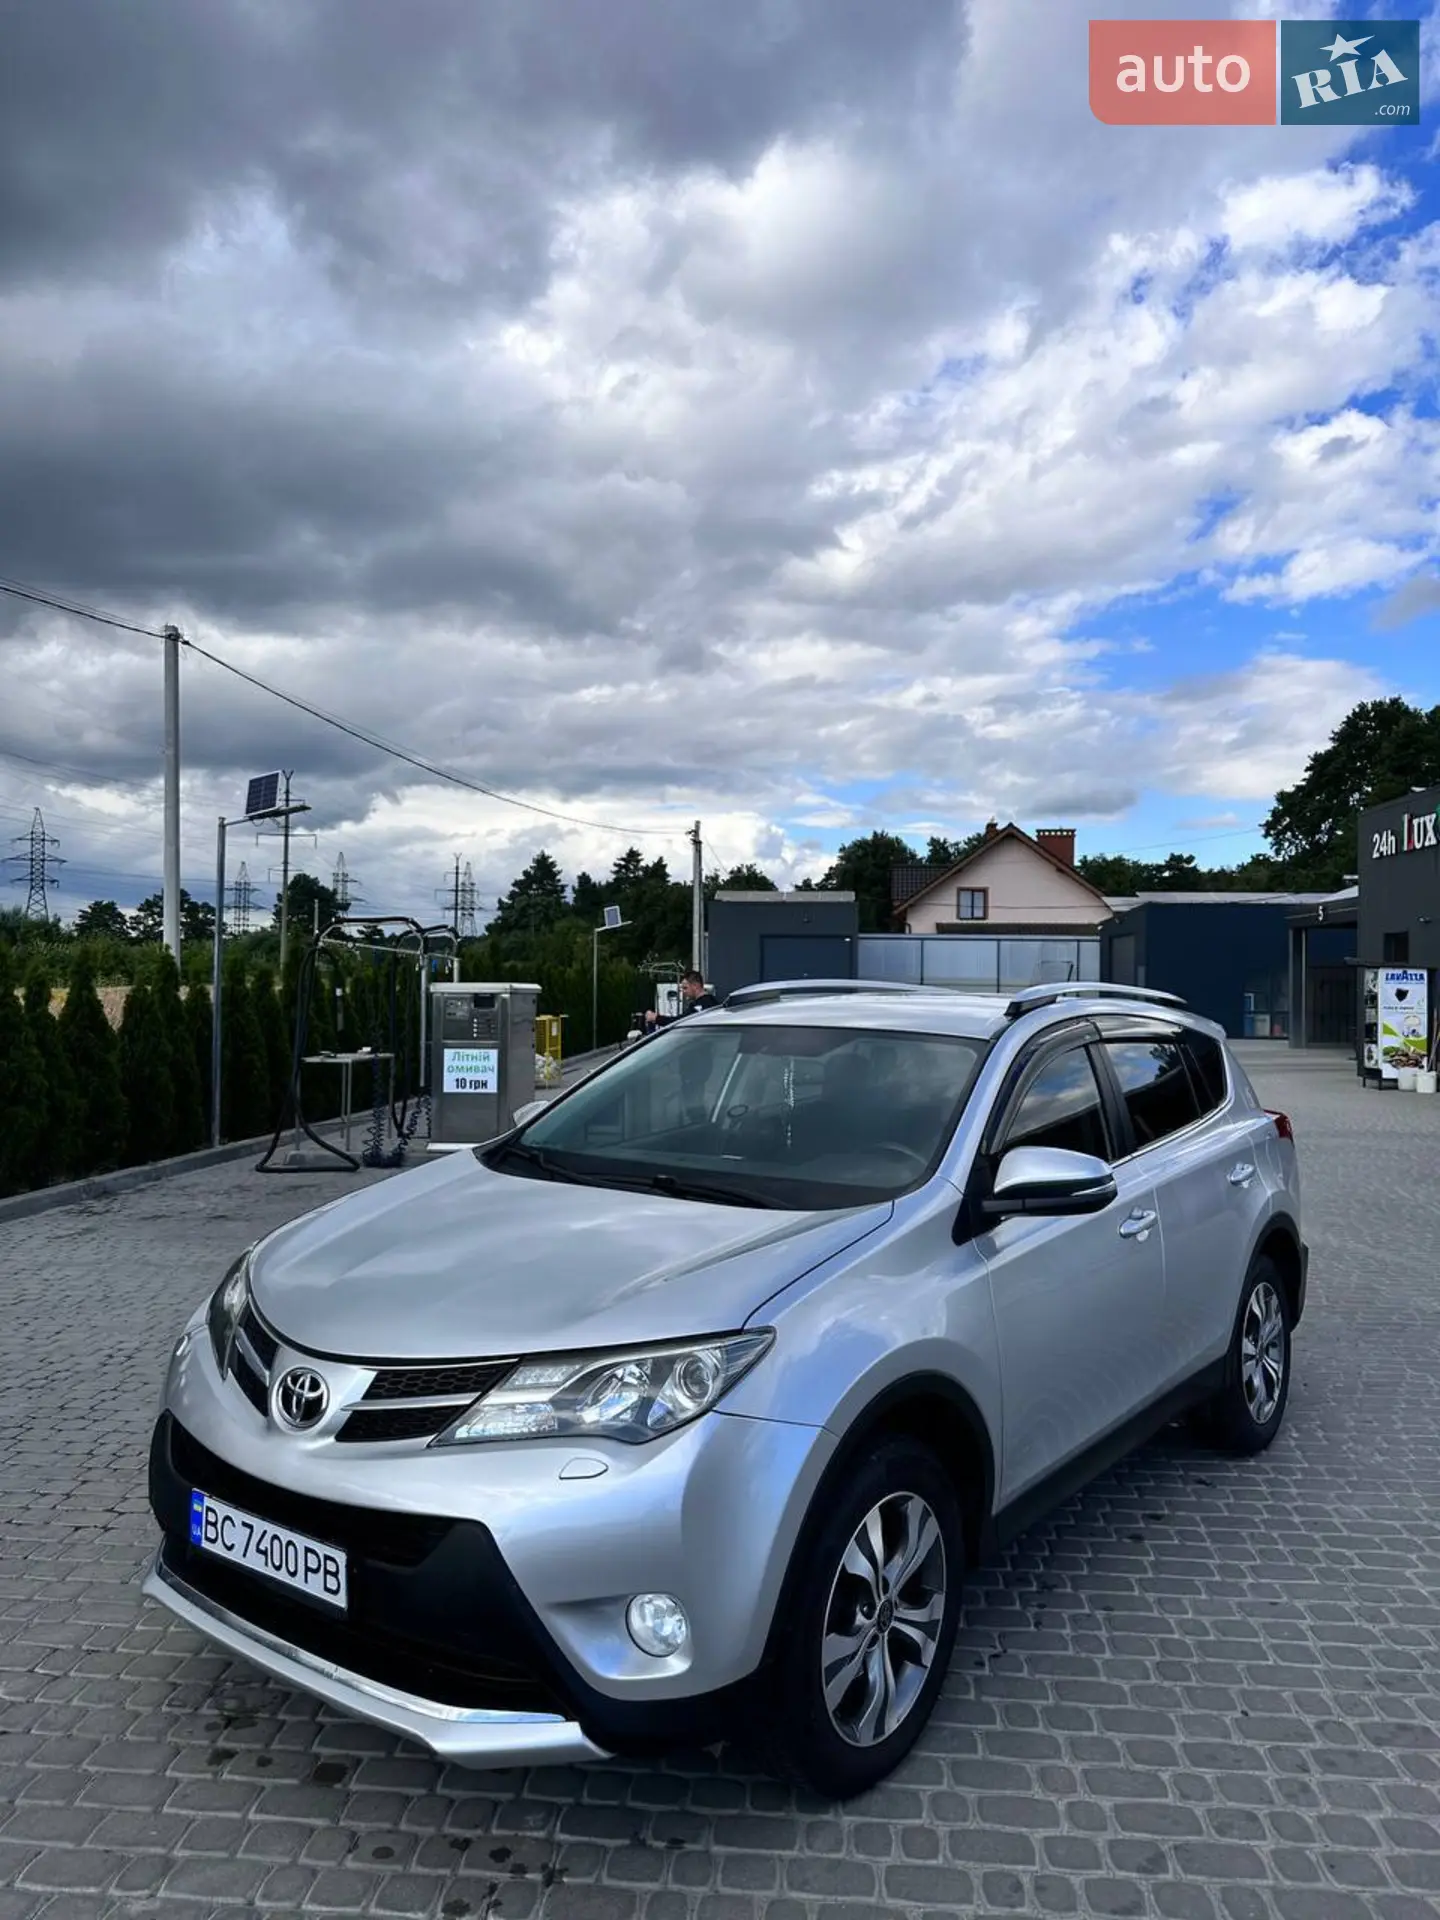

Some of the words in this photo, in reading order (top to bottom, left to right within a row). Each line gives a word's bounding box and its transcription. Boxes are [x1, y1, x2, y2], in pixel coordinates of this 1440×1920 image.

[1372, 829, 1396, 859] 24h
[452, 1051, 490, 1062] Літній
[447, 1065, 495, 1074] омивач
[455, 1077, 467, 1090] 10
[469, 1079, 488, 1091] грн
